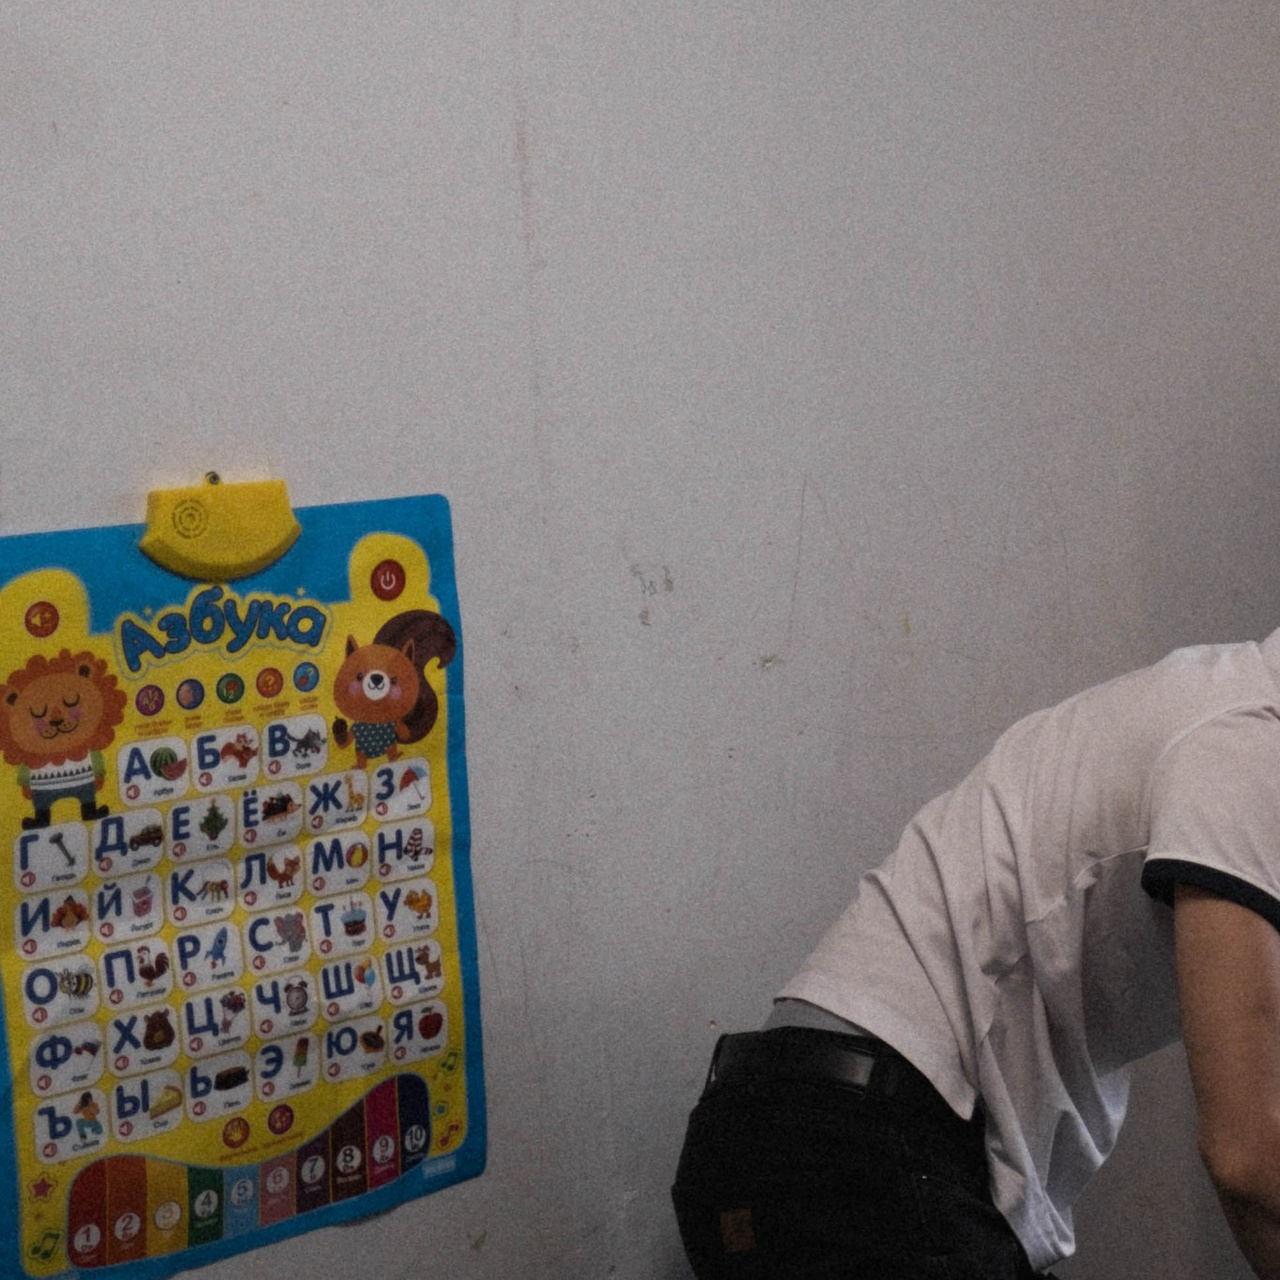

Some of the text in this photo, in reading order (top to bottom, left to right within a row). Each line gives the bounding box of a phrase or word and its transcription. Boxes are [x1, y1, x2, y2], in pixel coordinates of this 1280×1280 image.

[121, 586, 327, 672] Азбука
[197, 735, 220, 770] Б
[268, 724, 290, 758] В
[124, 747, 152, 783] А
[309, 780, 342, 815] Ж
[376, 768, 395, 800] З
[172, 806, 191, 840] Е
[243, 790, 259, 828] Ё
[20, 834, 40, 870] Г
[95, 816, 128, 861] Д
[312, 838, 344, 874] М
[378, 829, 404, 864] Н
[172, 869, 196, 905] К
[240, 853, 266, 889] Л
[21, 898, 50, 936] И
[98, 883, 122, 920] Й
[379, 888, 401, 921] У
[248, 918, 273, 952] С
[314, 904, 334, 937] Т
[104, 949, 135, 988] П
[177, 934, 201, 971] Р
[385, 947, 420, 985] Щ
[25, 968, 58, 1005] О
[256, 981, 281, 1014] Ч
[321, 962, 355, 999] Ш
[186, 997, 219, 1036] Ц
[393, 1010, 414, 1044] Я
[113, 1015, 141, 1054] Х
[326, 1026, 358, 1059] Ю
[36, 1035, 72, 1070] Ф
[260, 1045, 284, 1079] Э
[116, 1079, 150, 1119] Ы
[190, 1066, 212, 1098] Ь
[38, 1105, 72, 1140] Ъ
[407, 1127, 424, 1144] 10
[342, 1148, 354, 1164] 8
[379, 1138, 389, 1154] 9
[271, 1169, 284, 1185] 6
[308, 1158, 320, 1174] 7
[200, 1192, 212, 1208] 4
[236, 1180, 248, 1196] 5
[82, 1226, 91, 1242] 1
[122, 1215, 135, 1231] 2
